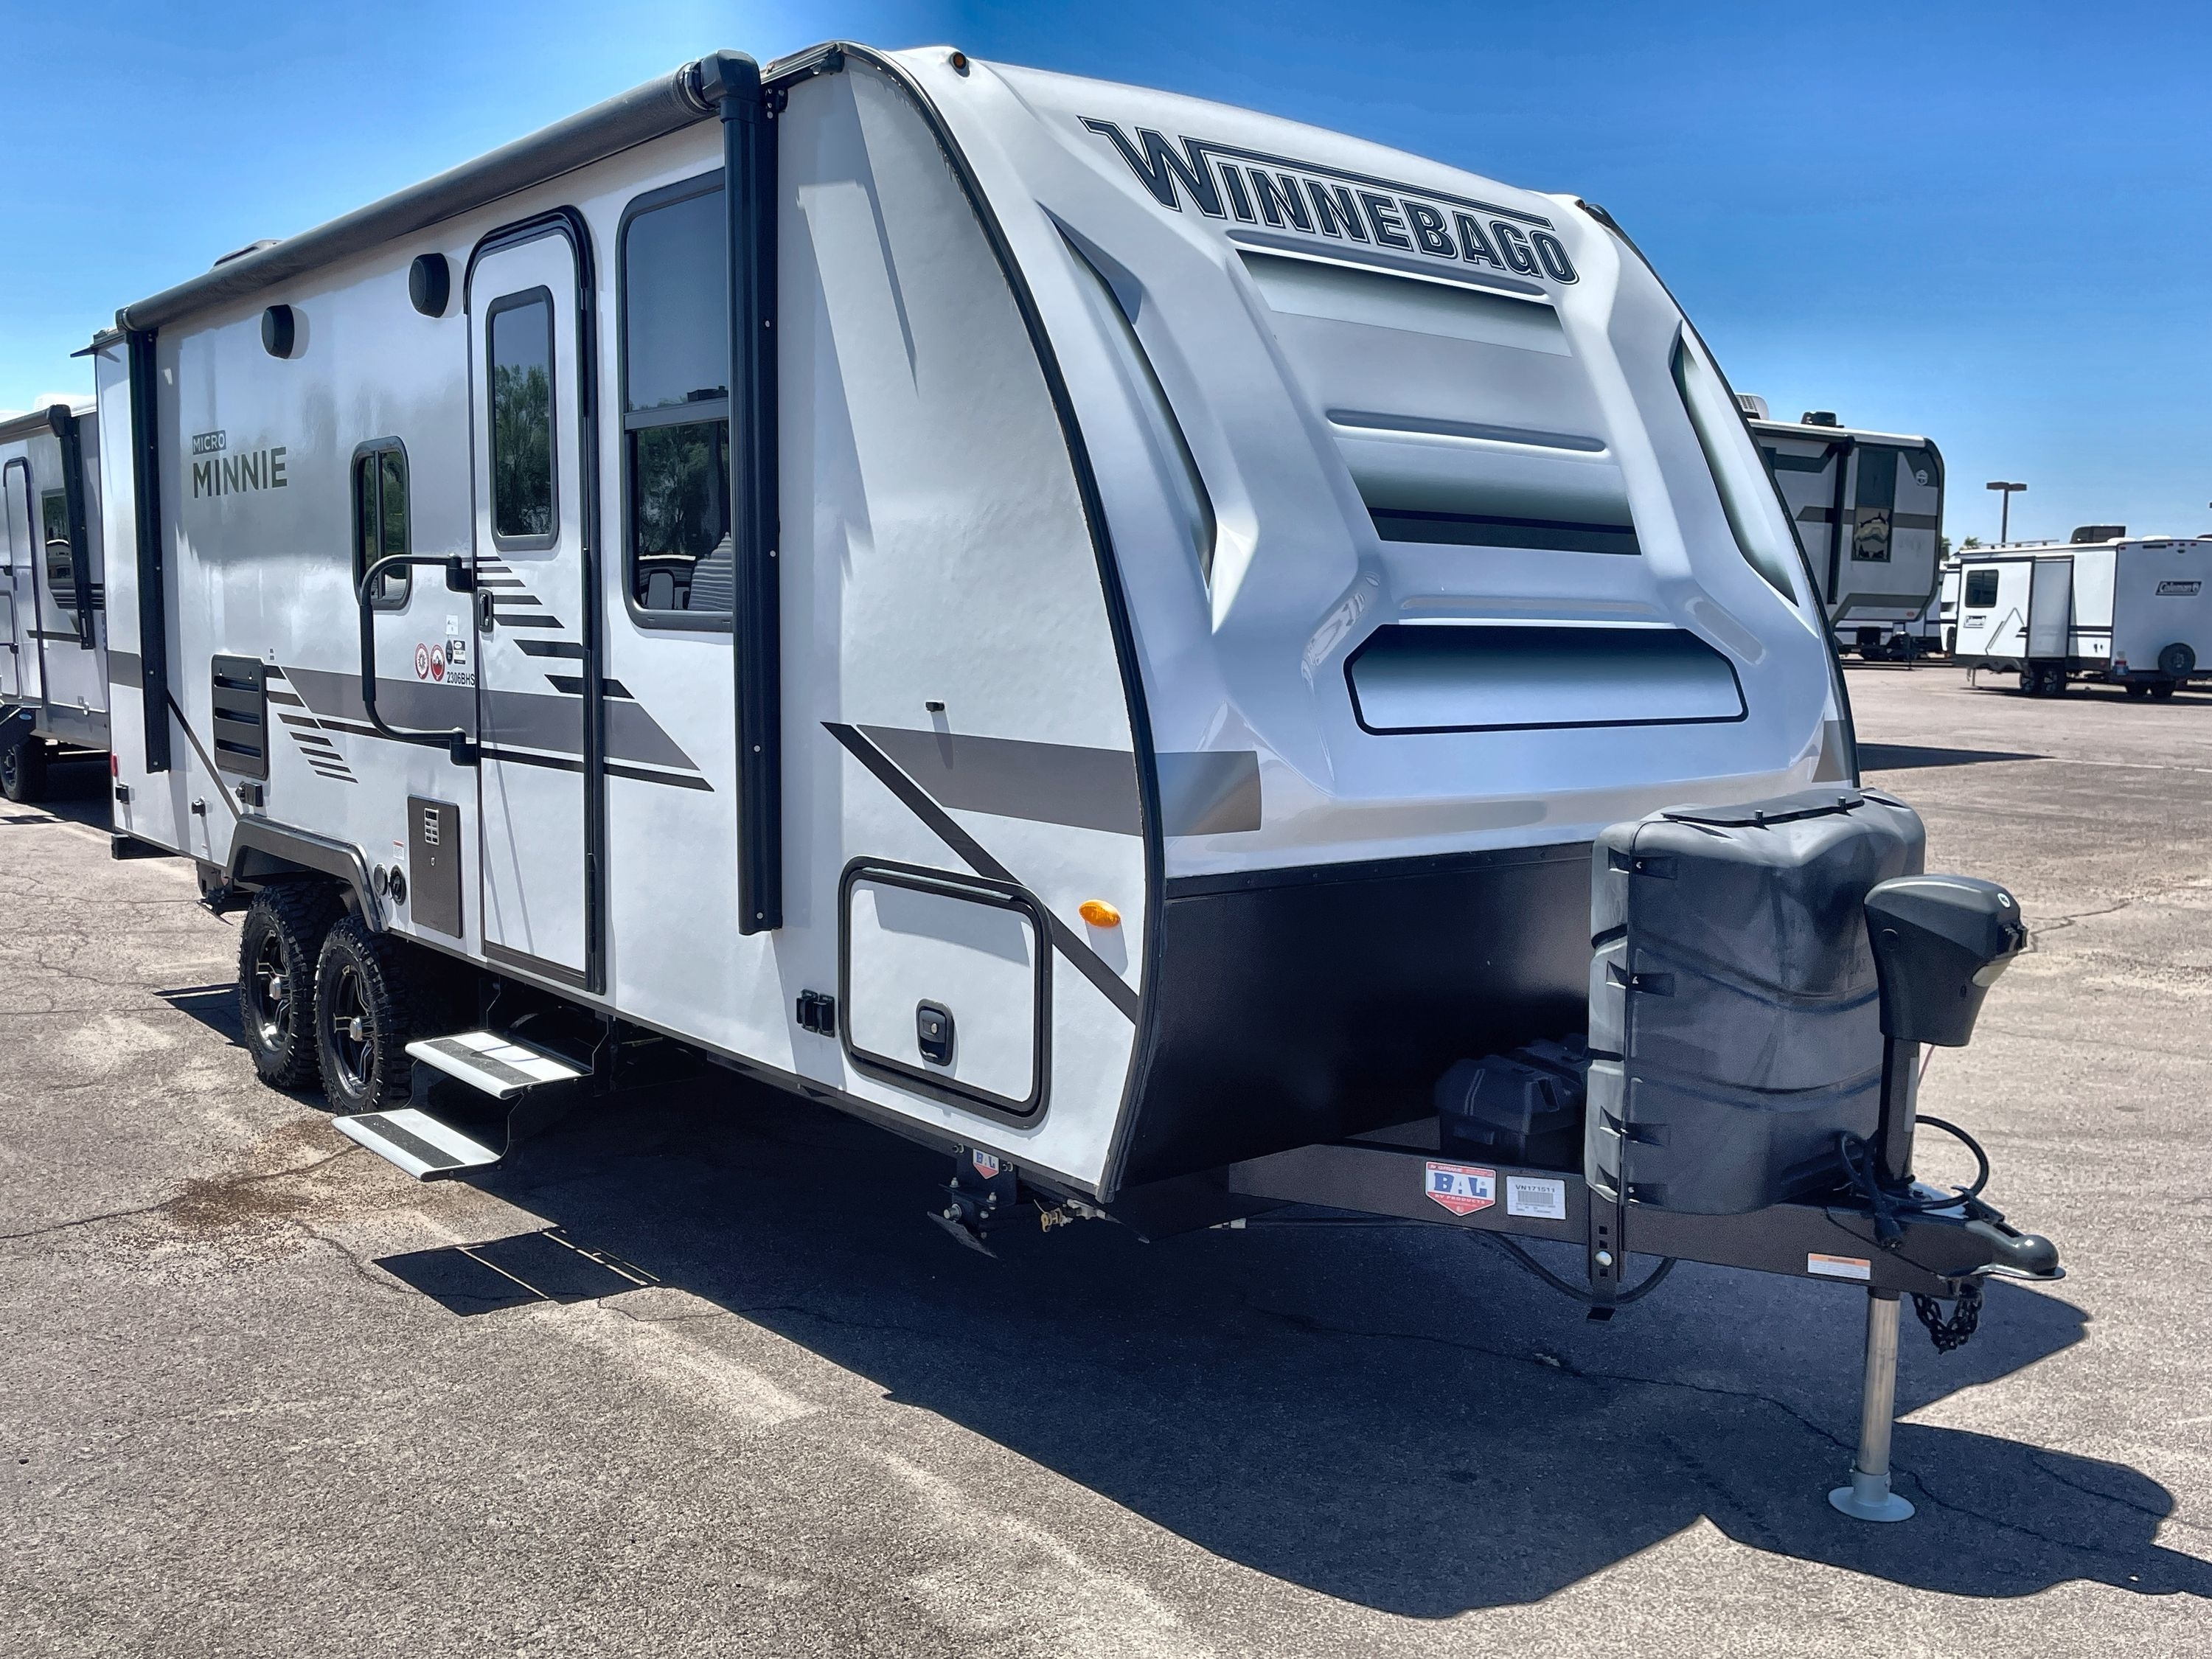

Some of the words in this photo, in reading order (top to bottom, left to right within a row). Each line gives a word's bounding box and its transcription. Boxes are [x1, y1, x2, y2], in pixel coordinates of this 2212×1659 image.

[1077, 115, 1580, 285] WINNEBAGO
[193, 433, 225, 452] MICRO
[193, 446, 288, 498] MINNIE
[447, 672, 475, 686] 2306BHS
[1434, 1172, 1487, 1198] BAL
[1446, 1196, 1486, 1205] PRODUCTS
